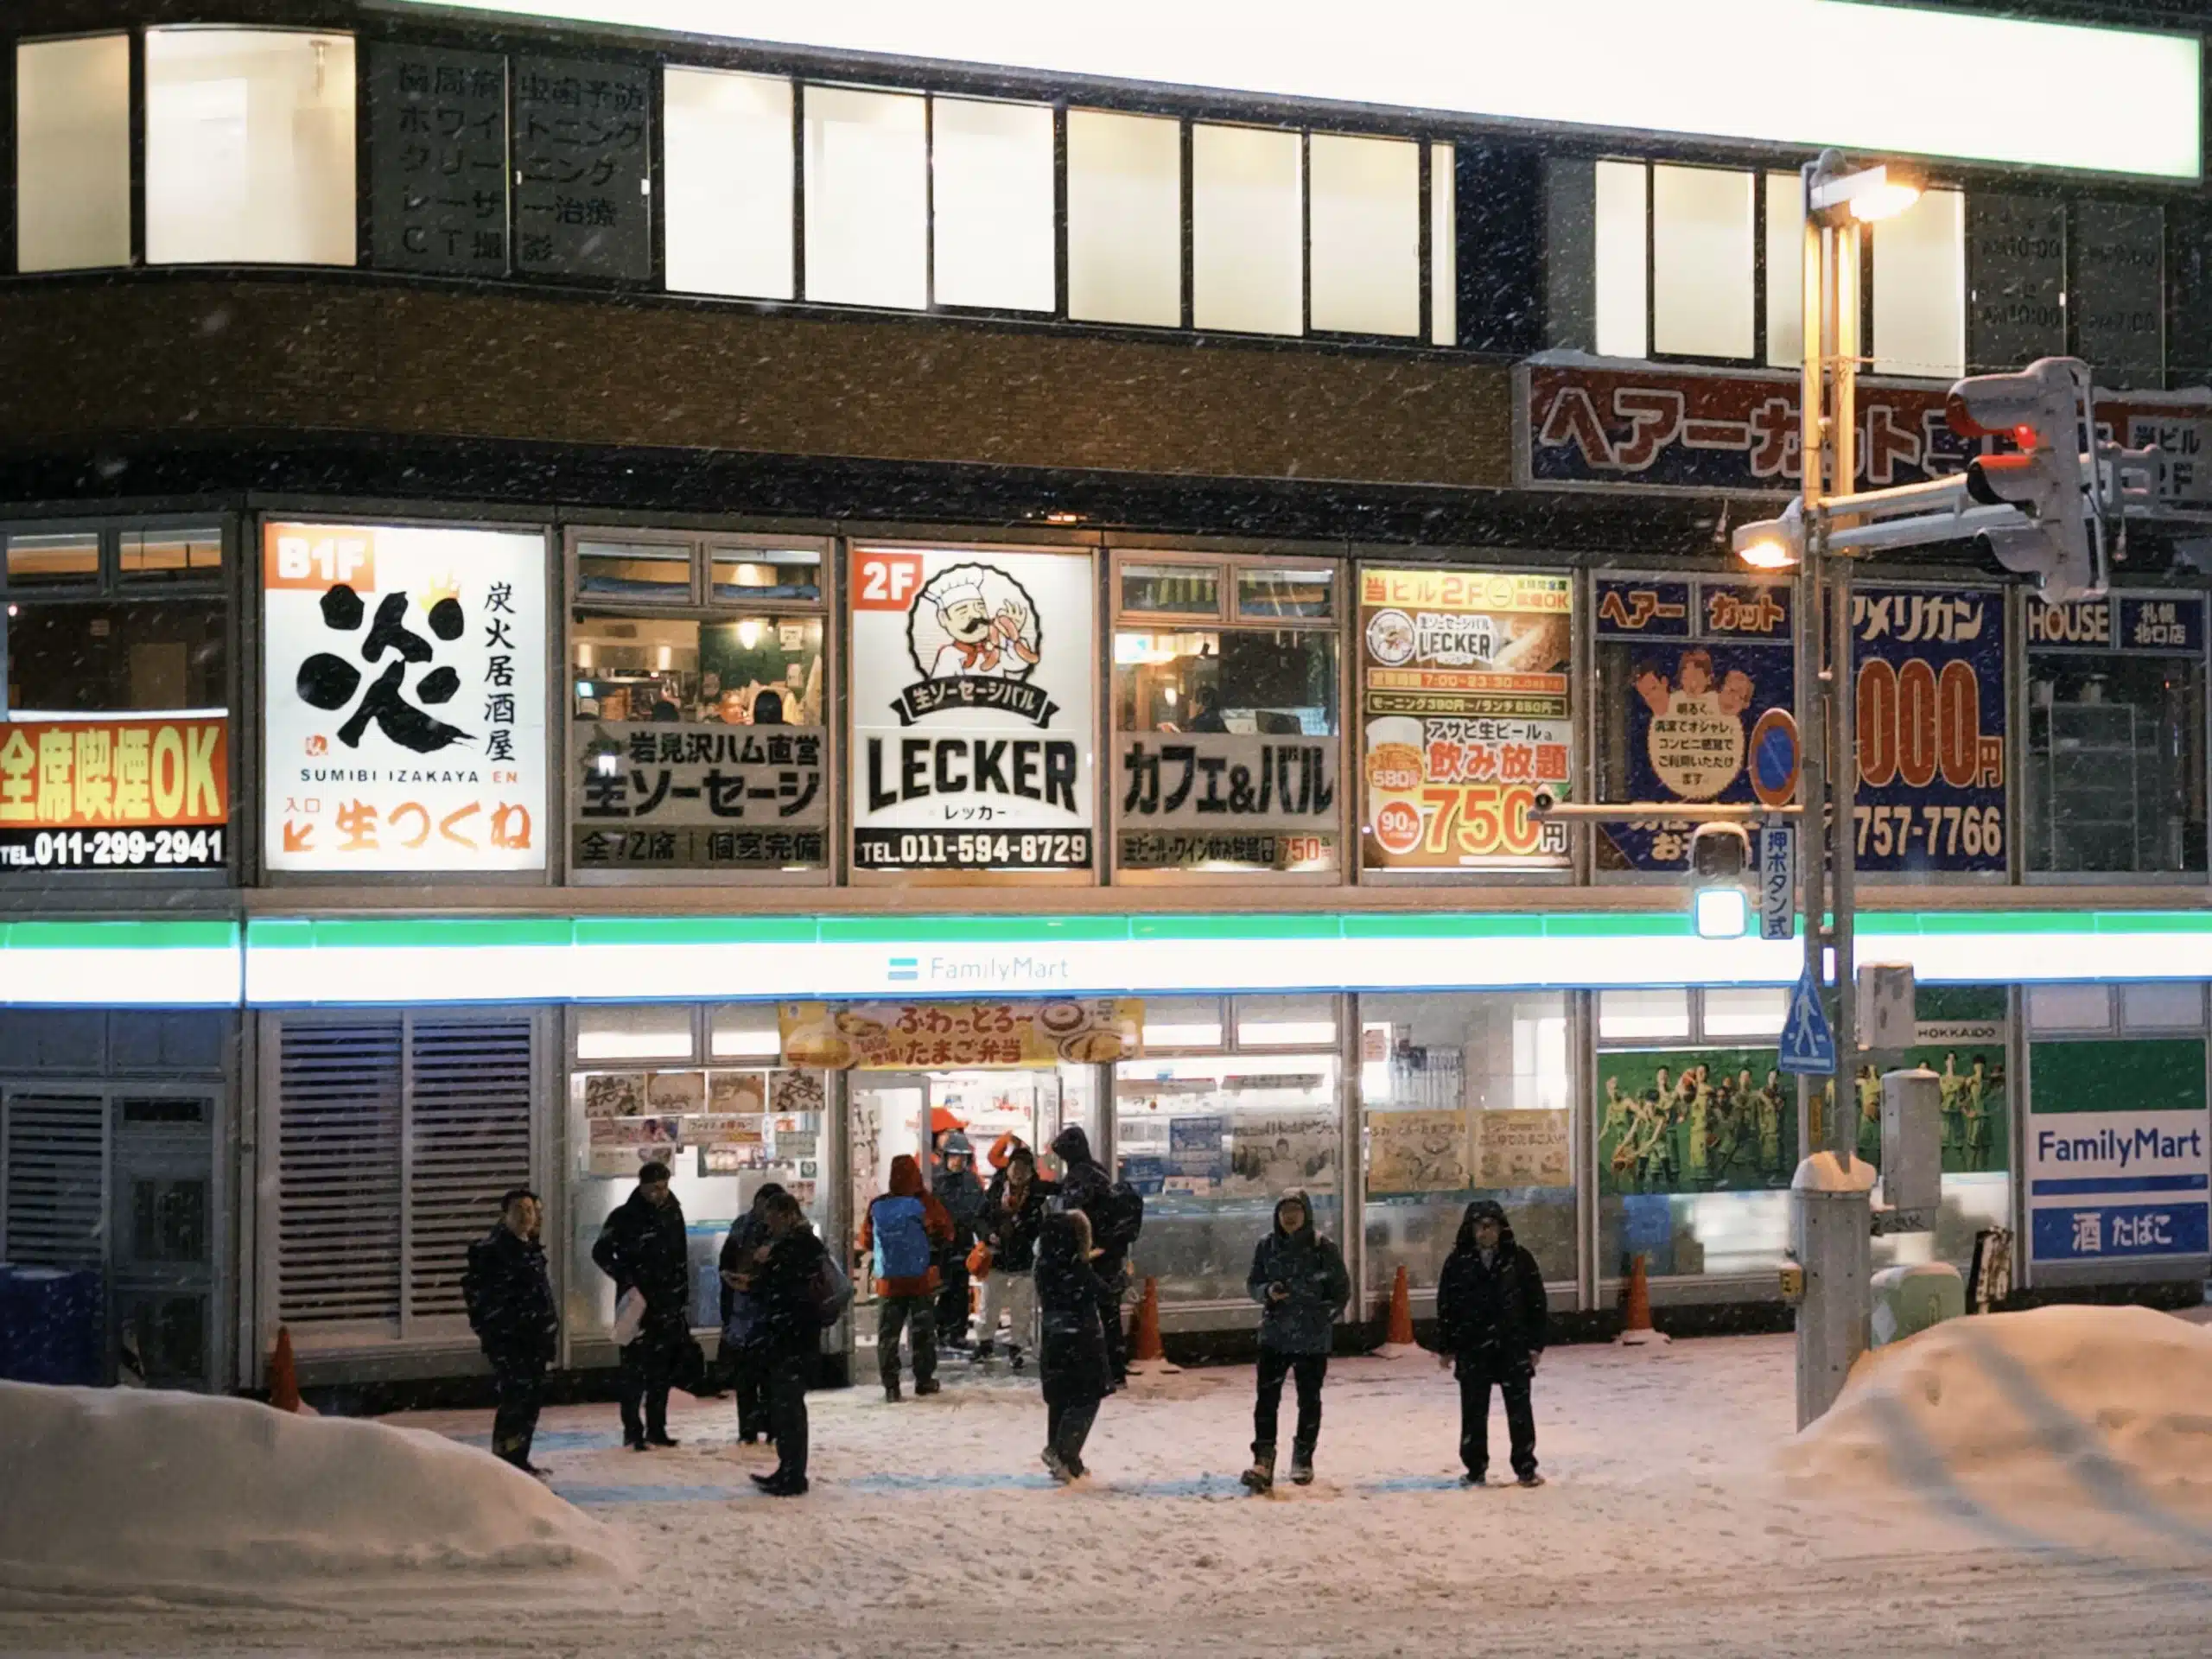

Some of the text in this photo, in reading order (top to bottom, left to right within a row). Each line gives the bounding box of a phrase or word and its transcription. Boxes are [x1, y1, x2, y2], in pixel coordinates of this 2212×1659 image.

[277, 536, 366, 582] B1F
[863, 561, 917, 602] 2F
[1599, 588, 1686, 630] ヘアー
[1709, 592, 1785, 632] カット
[2028, 602, 2109, 642] HOUSE
[1419, 631, 1491, 659] LECKER
[2133, 624, 2186, 645] 北口店
[484, 581, 518, 763] 炭火居酒屋
[912, 679, 1036, 710] 生ソーセージバル
[630, 731, 821, 766] 岩見沢ハム直営
[1429, 741, 1568, 781] 飲み放題
[0, 727, 222, 823] 全席喫煙OK
[301, 767, 518, 785] SUMIBI IZAKAYA EN
[581, 767, 822, 819] 生ソーセージ
[868, 736, 1079, 815] LECKER
[1123, 741, 1336, 819] カフェ&バル
[284, 797, 321, 815] 入口
[335, 797, 533, 851] 生つくね
[944, 804, 1007, 821] レッカー
[1767, 831, 1789, 939] 押ボタン式
[931, 957, 1069, 981] FamilyMart
[905, 1038, 1022, 1065] たまご弁当
[1918, 1027, 1996, 1039] HOKKAIDO
[2037, 1128, 2202, 1168] FamilyMart
[2072, 1212, 2173, 1252] 酒 たばこ
